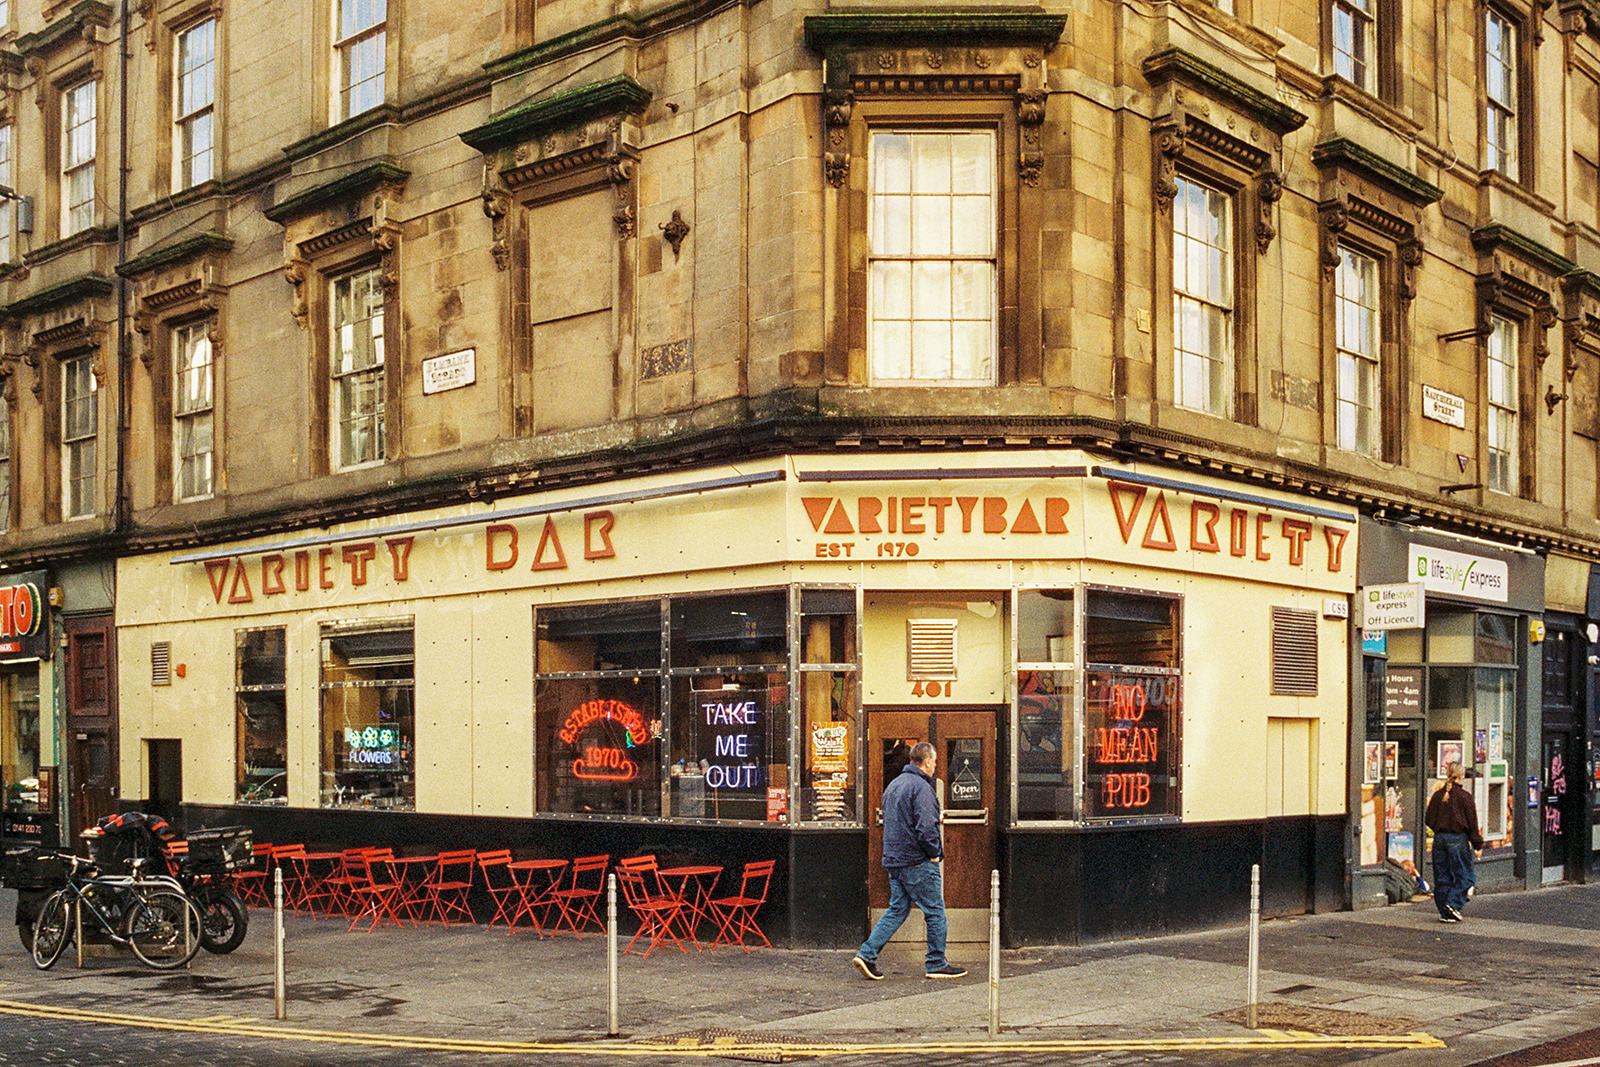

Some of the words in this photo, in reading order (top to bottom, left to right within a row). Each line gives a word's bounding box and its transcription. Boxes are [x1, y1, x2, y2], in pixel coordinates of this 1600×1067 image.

[1107, 480, 1350, 572] VARIETY
[204, 536, 415, 604] VARIETY
[486, 510, 616, 572] BAR
[815, 543, 855, 557] EST
[877, 542, 920, 557] 1970
[1431, 559, 1463, 586] lifestyle
[1470, 568, 1501, 591] express
[1376, 601, 1407, 611] express
[1383, 590, 1415, 601] lifestyle
[1368, 617, 1381, 625] Off
[1384, 616, 1415, 625] Licence
[911, 681, 951, 698] 401
[1403, 686, 1419, 695] 4am
[1114, 684, 1145, 722] NO
[1403, 698, 1418, 706] 4am
[559, 699, 647, 745] ESTABLISHED
[702, 702, 757, 725] TAKE
[715, 734, 748, 757] ME
[1099, 727, 1158, 764] MEAN
[349, 749, 392, 765] FLOWERS
[585, 747, 620, 768] 1970
[706, 765, 756, 788] OUT
[953, 784, 979, 796] Open
[1106, 773, 1151, 808] PUB
